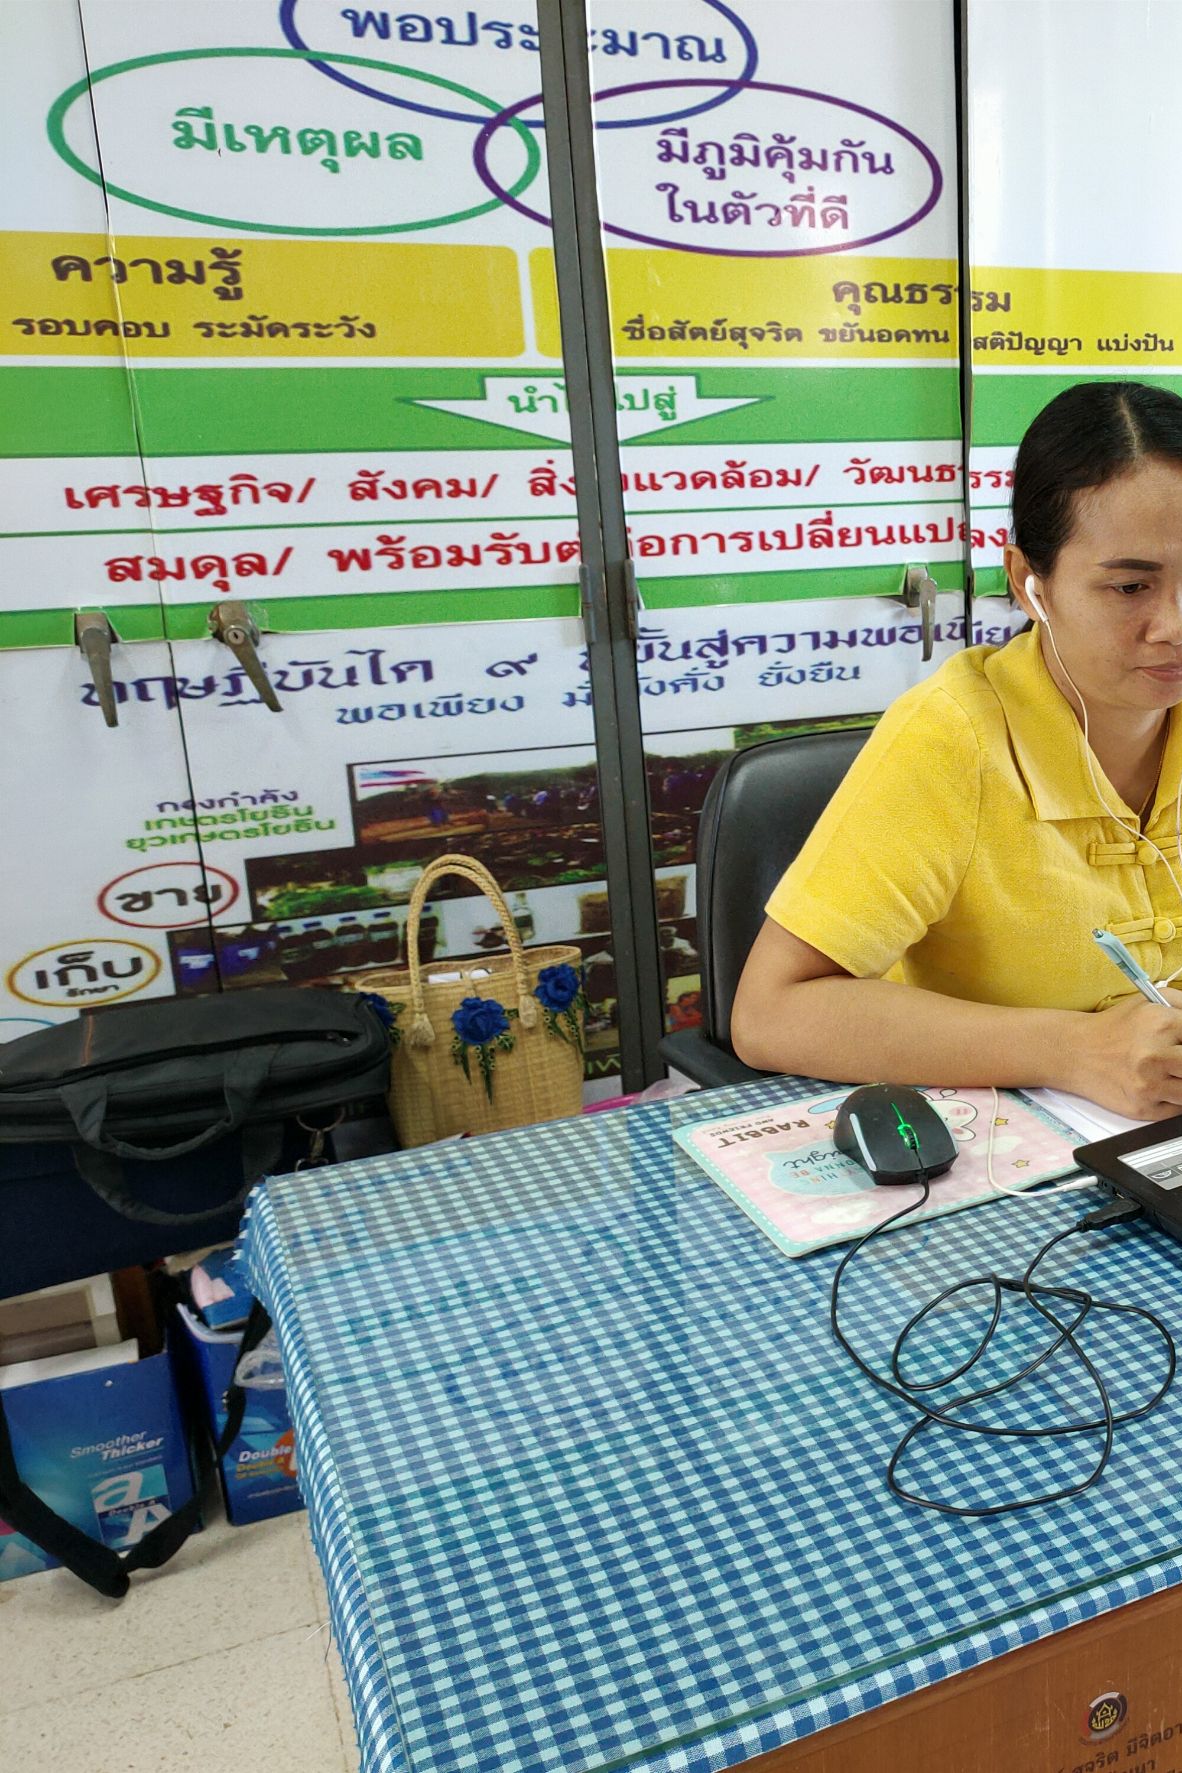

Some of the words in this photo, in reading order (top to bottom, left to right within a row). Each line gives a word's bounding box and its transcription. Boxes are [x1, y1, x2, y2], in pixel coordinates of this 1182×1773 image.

[171, 106, 424, 174] มีเหตุผล
[655, 127, 896, 182] มีภูมิคุ้มกัน
[655, 182, 851, 230] ในตัวที่ดี
[51, 246, 244, 302] ความรู้
[833, 281, 1012, 317] คุณธรรม
[12, 315, 170, 340] รอบคอบ
[193, 314, 378, 342] ระมัดระวัง
[819, 322, 949, 345] ขยันอดทน
[973, 331, 1083, 356] สติปัญญา
[1097, 331, 1175, 353] แบ่งปัน
[64, 474, 316, 516] เศรษฐกิจ/
[348, 469, 498, 502] สังคม/
[105, 546, 293, 592] สมดุล/
[336, 693, 524, 726] พอเพียง
[759, 661, 860, 687] ยั่งยืน
[115, 884, 223, 913] ขาย
[35, 951, 143, 989] เก็บ
[717, 1119, 811, 1149] RABBIT
[814, 1159, 856, 1172] ONNA
[70, 1431, 147, 1459] Smoother
[101, 1437, 164, 1461] Thicker
[239, 1445, 293, 1463] Double
